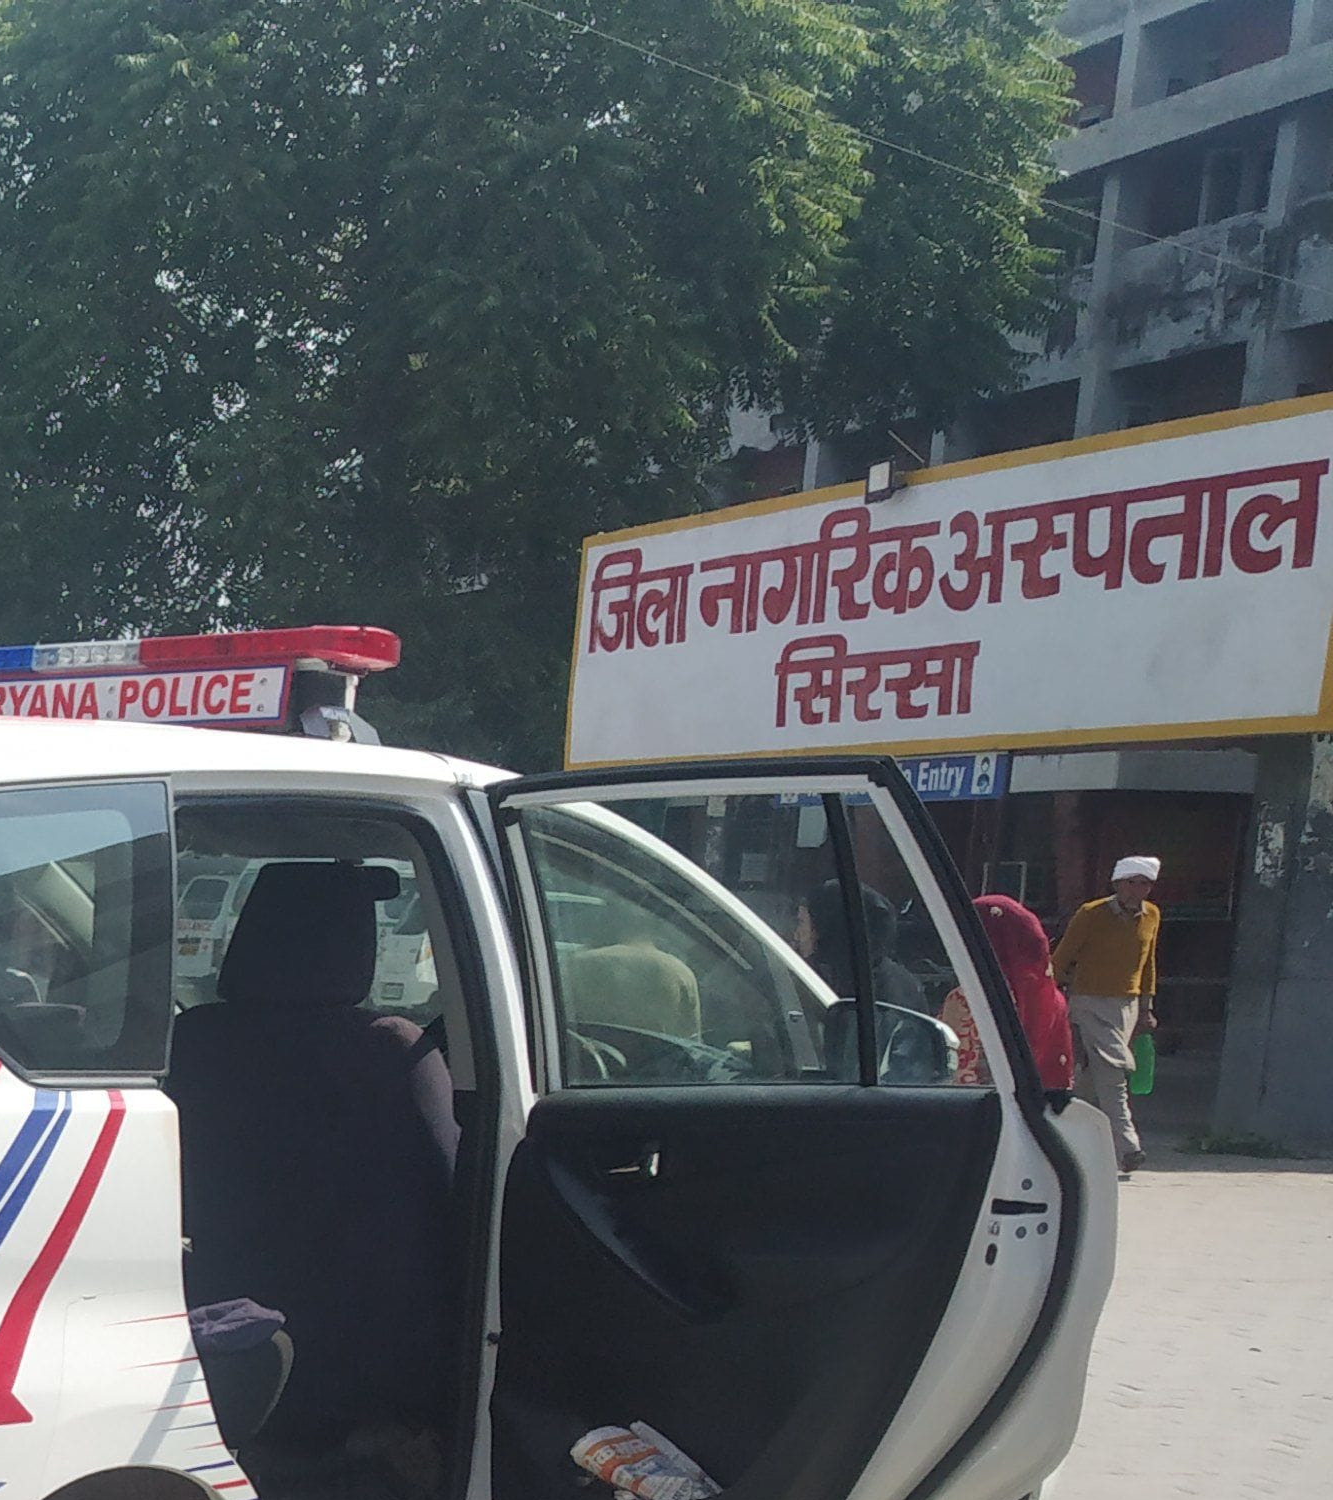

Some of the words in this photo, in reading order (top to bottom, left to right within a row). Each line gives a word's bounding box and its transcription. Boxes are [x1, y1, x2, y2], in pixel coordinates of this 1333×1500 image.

[588, 548, 695, 655] जिला
[698, 505, 941, 635] नागरिक
[938, 457, 1331, 613] अस्पताल
[117, 672, 255, 720] POLICE
[774, 633, 982, 728] सिरसा
[916, 760, 967, 798] Entry
